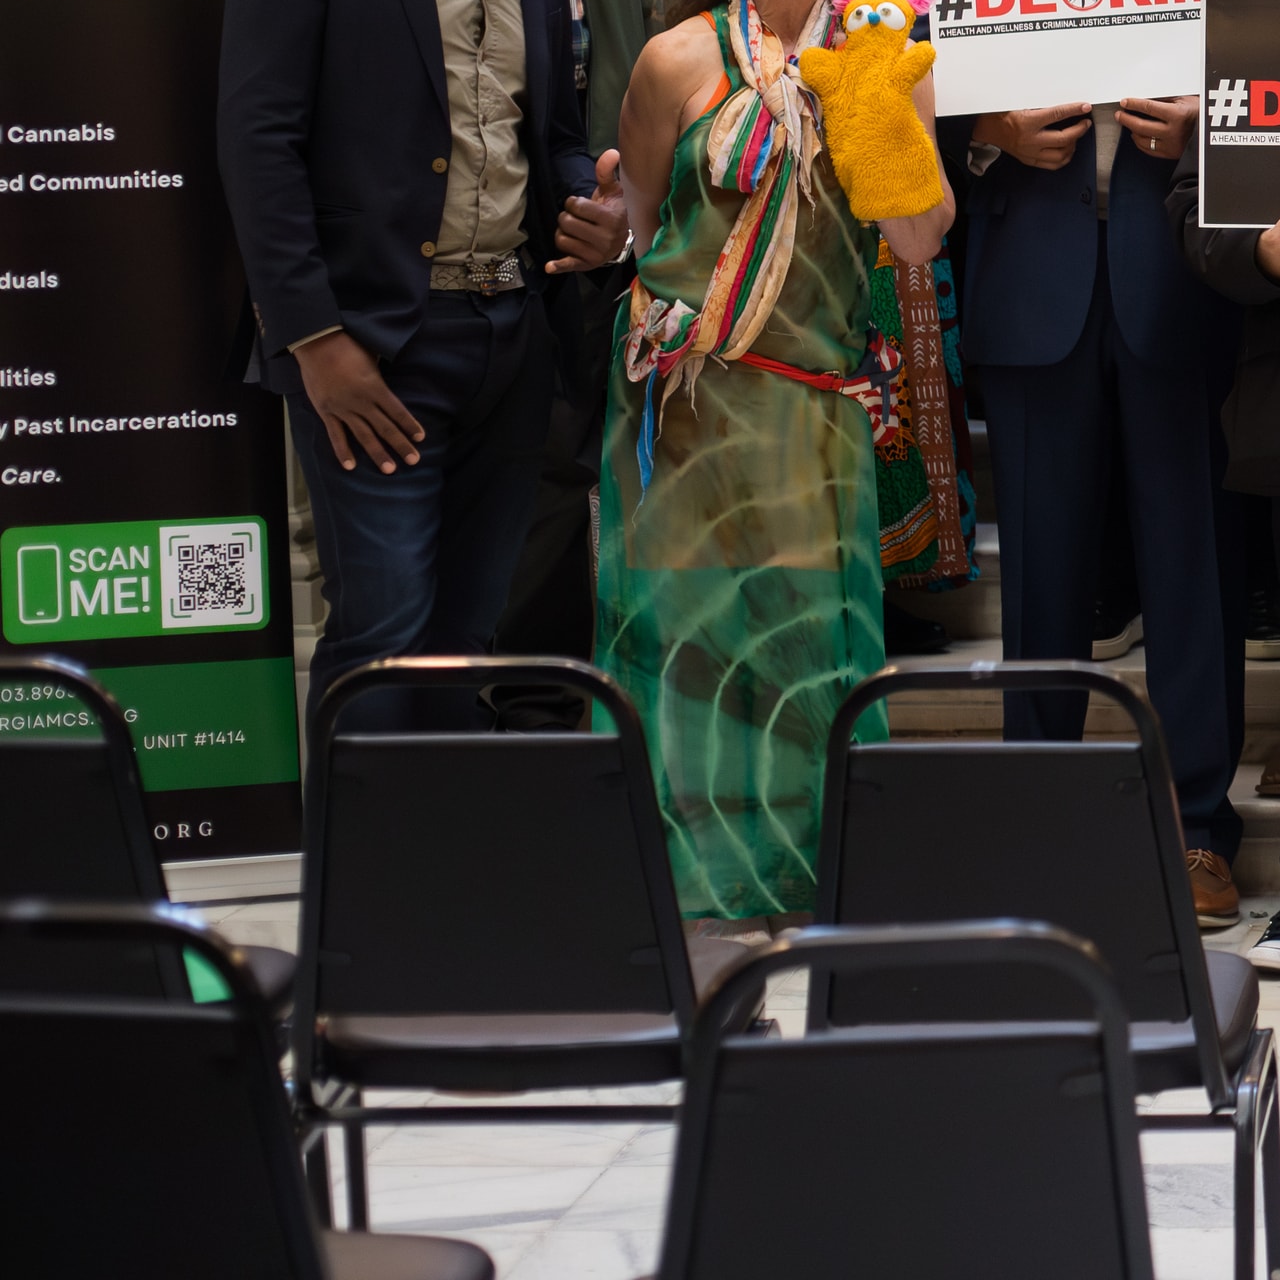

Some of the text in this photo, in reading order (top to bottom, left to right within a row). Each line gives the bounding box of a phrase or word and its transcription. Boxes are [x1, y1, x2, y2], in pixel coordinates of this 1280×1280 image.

[946, 27, 976, 37] HEALTH
[976, 26, 993, 35] AND
[993, 22, 1034, 34] WELLNESS
[1035, 21, 1042, 30] &
[1042, 19, 1078, 29] CRIMINAL
[1079, 17, 1110, 27] JUSTICE
[1111, 14, 1144, 24] REFORM
[1144, 11, 1185, 22] INITIATIVE.
[7, 123, 115, 143] Cannabis
[1218, 135, 1248, 143] HEALTH
[1250, 135, 1266, 143] AND
[29, 170, 184, 192] Communities
[14, 418, 64, 436] Past
[69, 410, 238, 434] Incarcerations
[1, 468, 61, 485] Care.
[69, 545, 150, 573] SCAN
[70, 576, 151, 617] ME!
[143, 729, 246, 750] UNIT #1414
